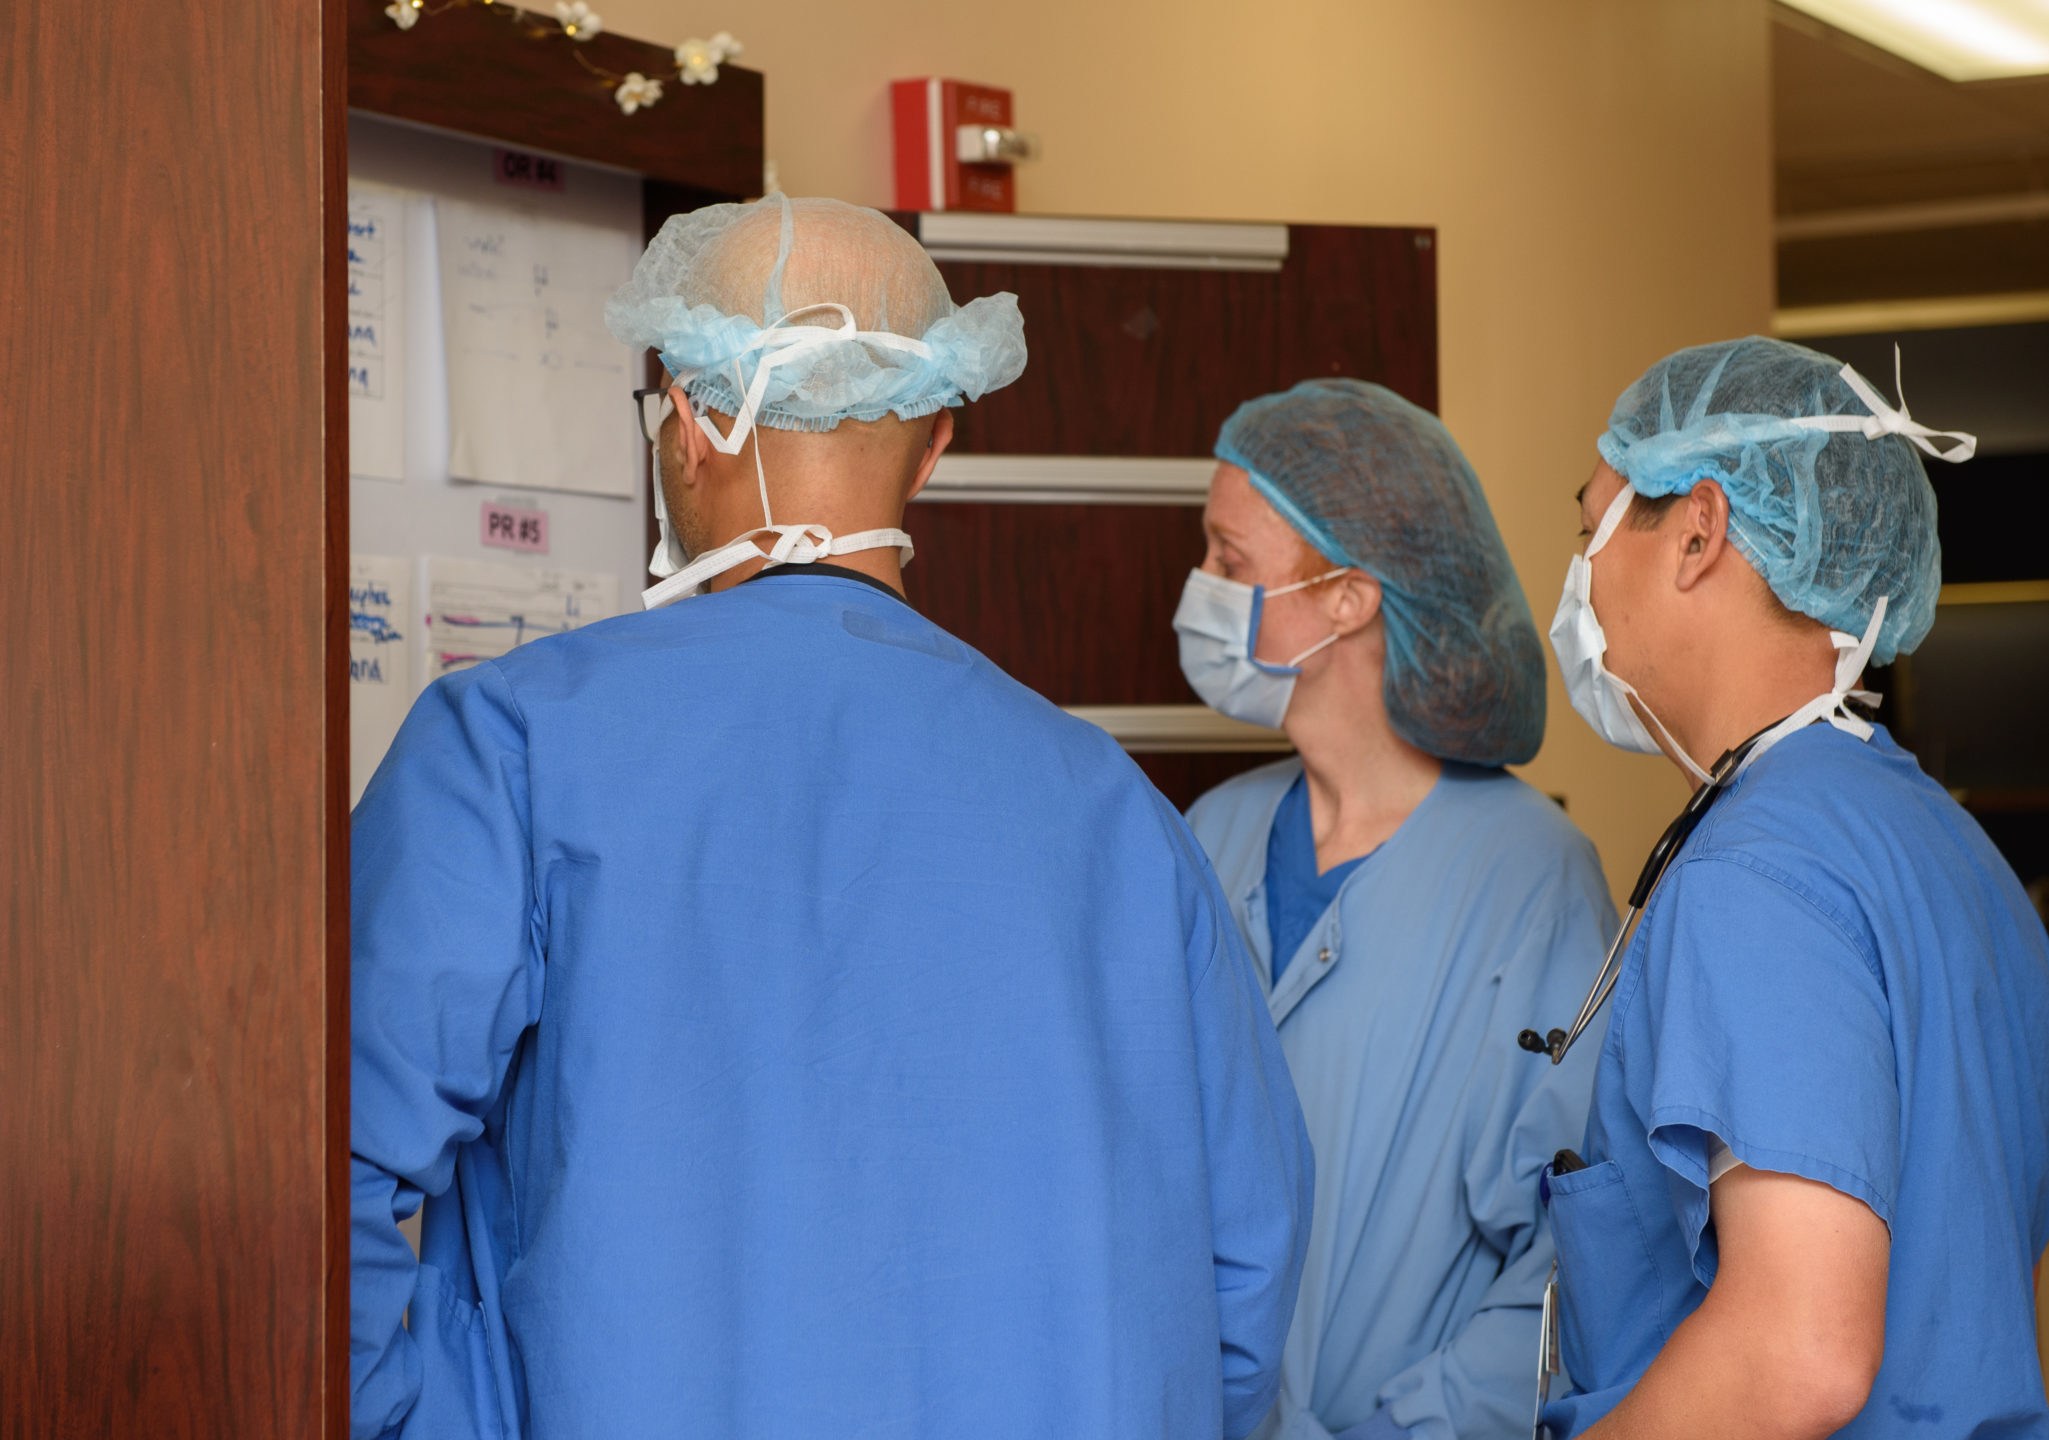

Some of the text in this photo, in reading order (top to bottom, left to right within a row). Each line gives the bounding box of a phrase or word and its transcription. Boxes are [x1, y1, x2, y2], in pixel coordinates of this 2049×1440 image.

[966, 96, 1000, 120] FIRE
[503, 151, 532, 180] OR
[969, 176, 1003, 200] FIRE
[488, 511, 541, 545] PR #5
